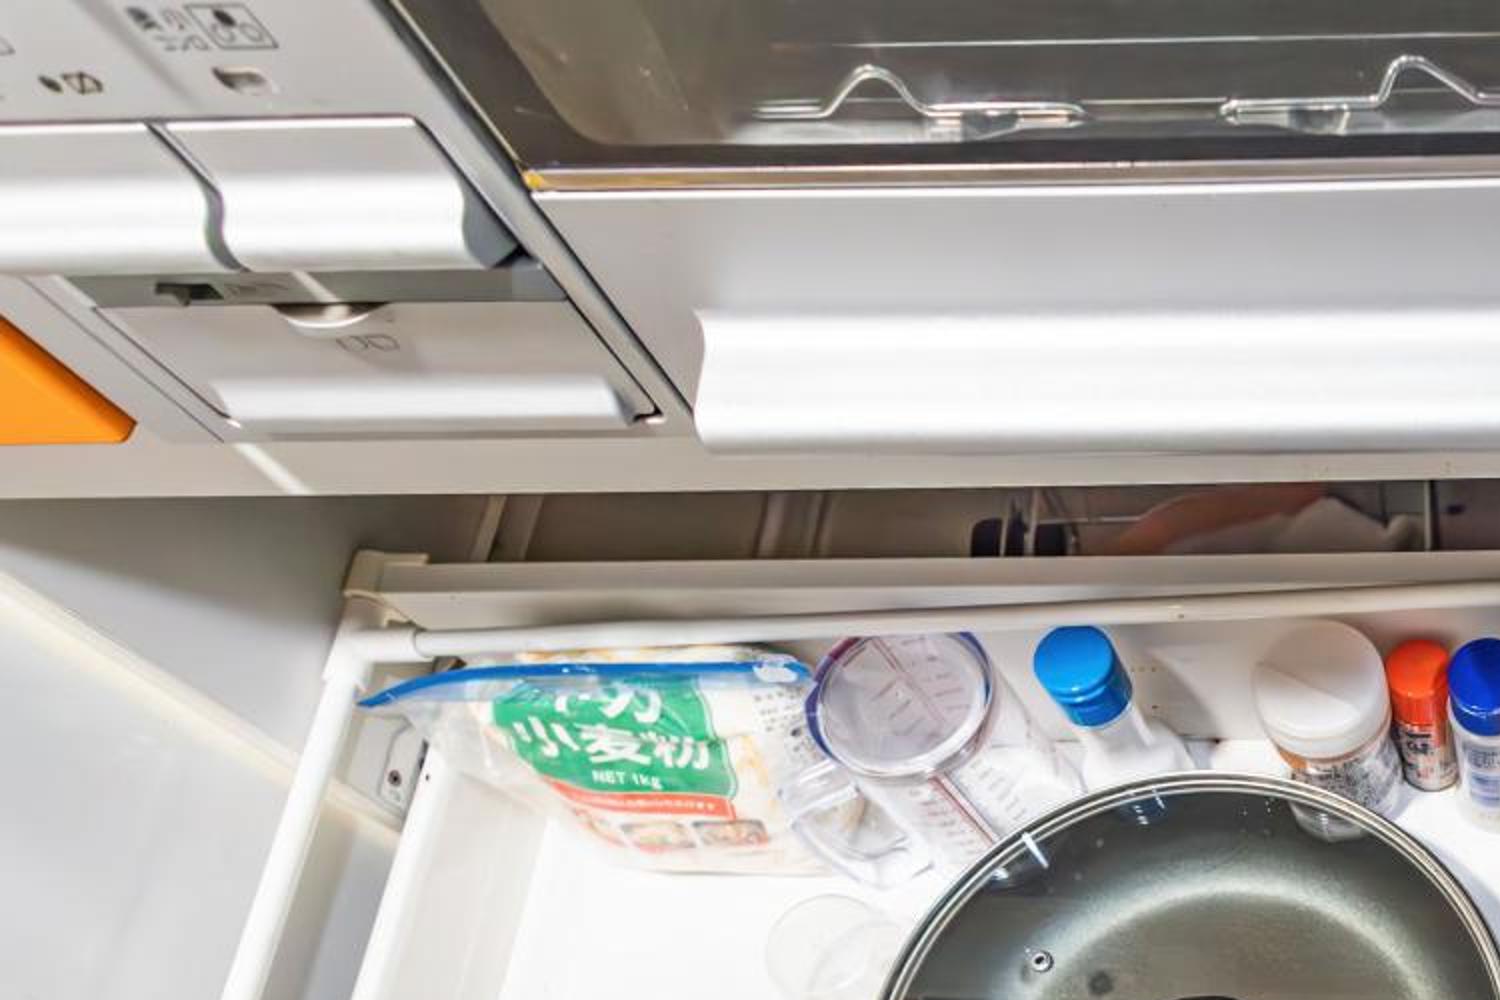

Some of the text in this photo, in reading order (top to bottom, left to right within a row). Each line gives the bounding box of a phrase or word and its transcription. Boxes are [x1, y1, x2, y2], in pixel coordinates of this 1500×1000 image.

[513, 715, 709, 770] 小麦粉
[592, 770, 626, 785] NET
